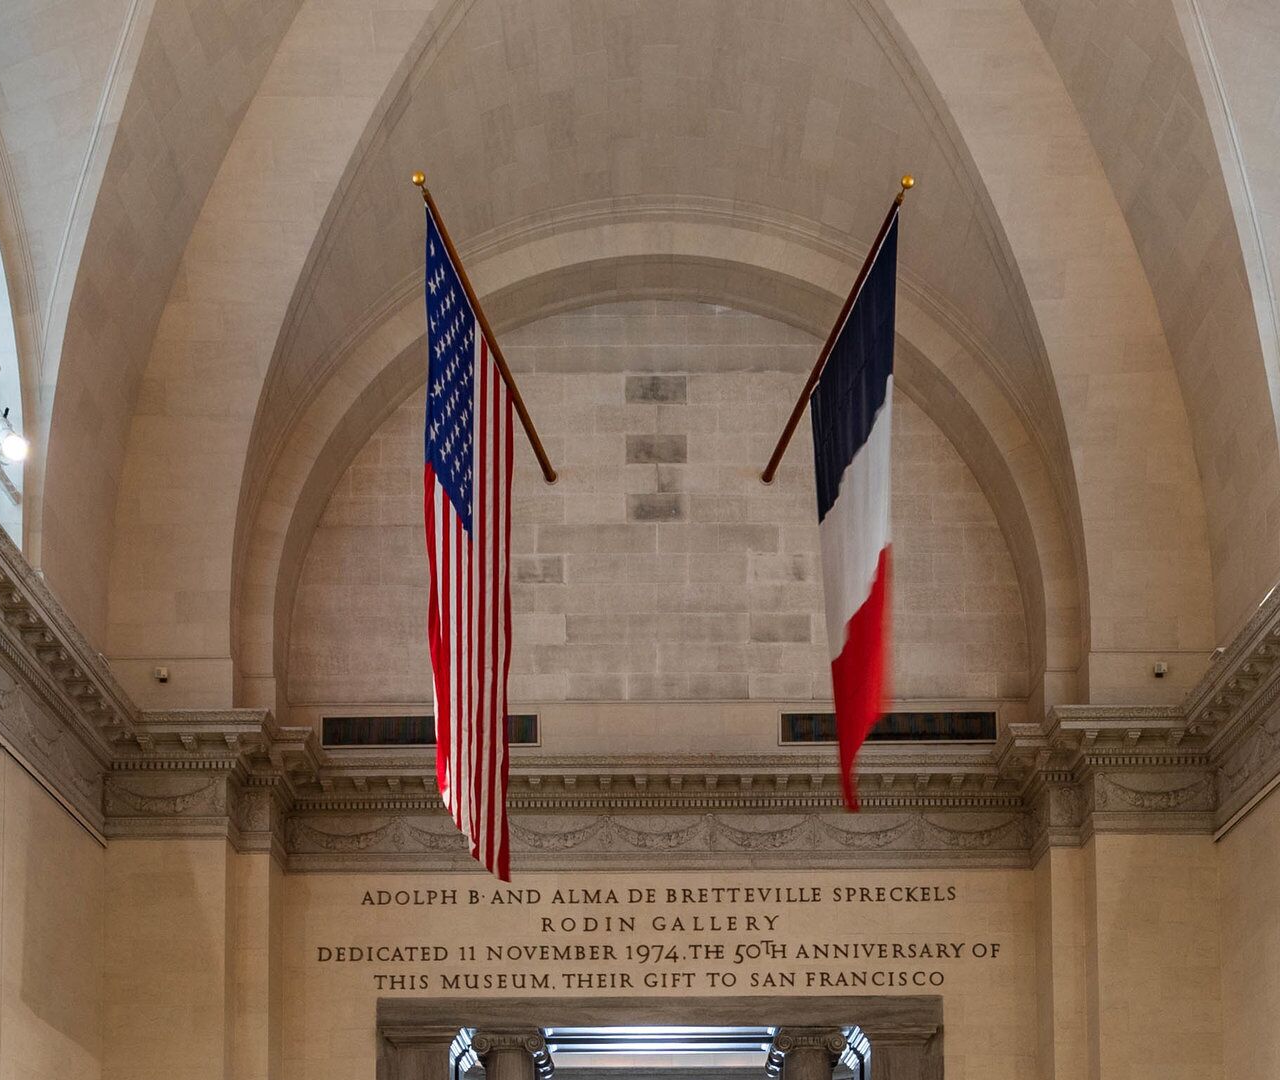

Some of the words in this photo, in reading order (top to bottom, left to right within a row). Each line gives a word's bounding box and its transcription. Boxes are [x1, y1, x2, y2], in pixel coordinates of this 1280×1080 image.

[361, 889, 458, 906] ADOLPH
[491, 889, 542, 905] AND
[552, 888, 620, 905] ALMA
[628, 888, 657, 904] DE
[666, 887, 822, 904] BRETTEVILLE
[832, 886, 956, 903] SPRECKELS
[541, 916, 636, 933] RODIN
[652, 915, 780, 932] GALLERY
[317, 946, 449, 963] DEDICATED
[459, 946, 477, 962] 11
[486, 945, 618, 961] NOVEMBER
[688, 944, 725, 961] THE
[796, 943, 966, 960] ANNIVERSARY
[972, 943, 1001, 959] OF
[374, 974, 429, 991] THIS
[562, 973, 635, 989] THEIR
[644, 972, 697, 988] GIFT
[706, 972, 737, 988] TO
[750, 971, 797, 988] SAN
[806, 970, 945, 988] FRANCISCO
